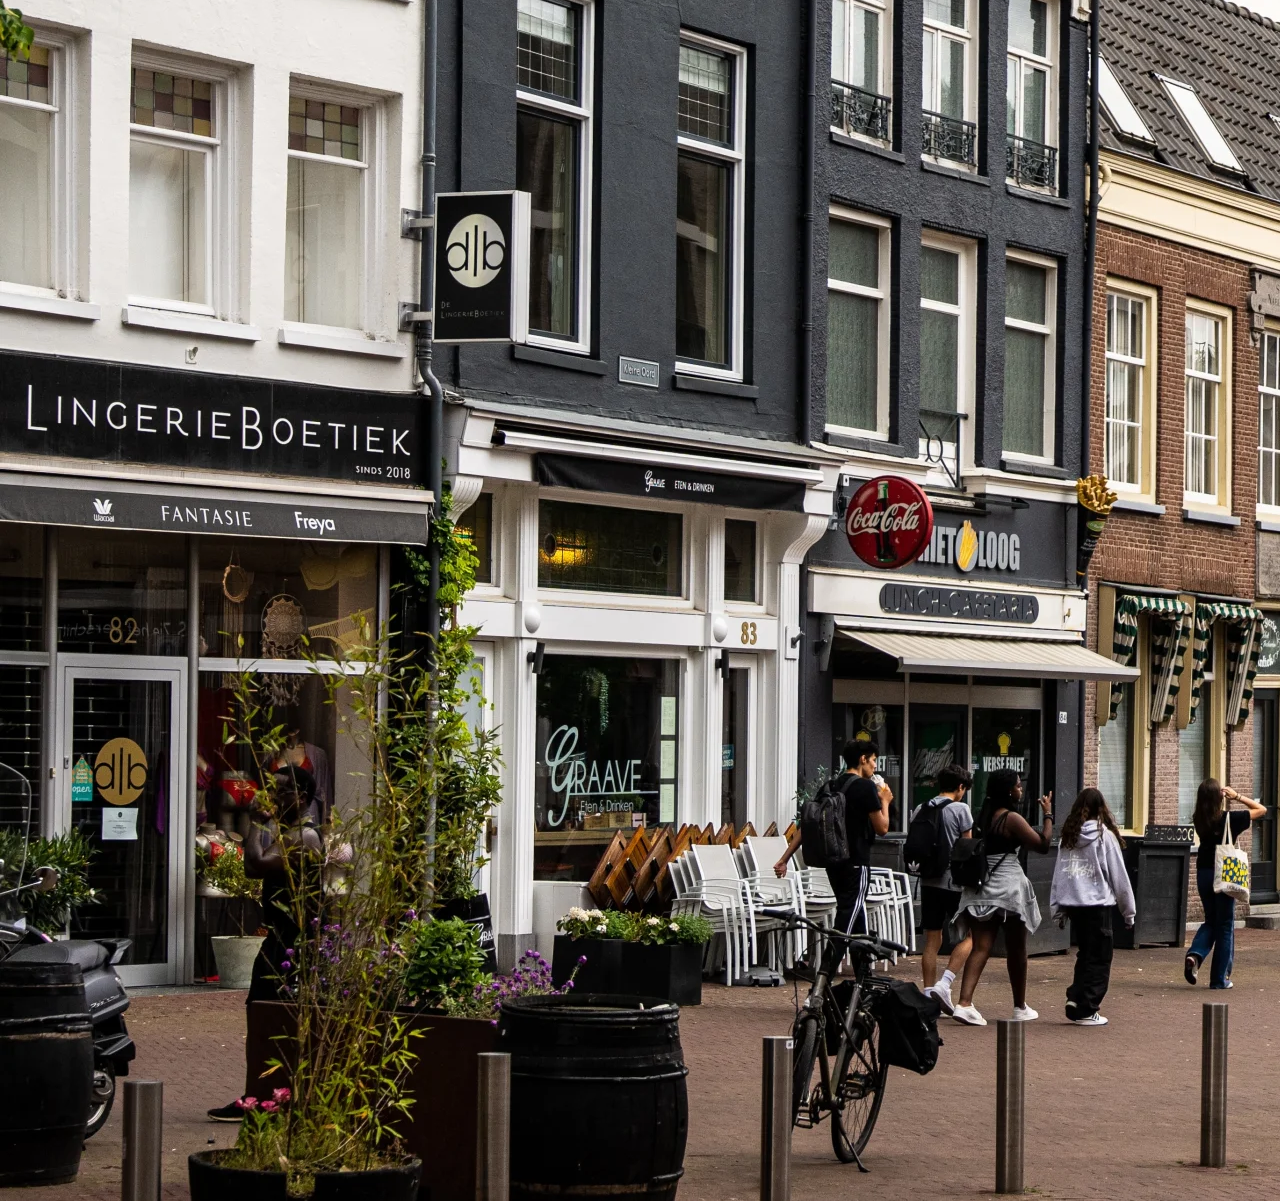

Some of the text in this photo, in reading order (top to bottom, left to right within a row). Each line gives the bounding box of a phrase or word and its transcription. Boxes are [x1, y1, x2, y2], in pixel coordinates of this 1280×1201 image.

[623, 364, 655, 378] Kleine Oord
[355, 465, 411, 479] SINDS 2018
[674, 480, 687, 490] ETEN
[687, 483, 692, 491] &
[692, 483, 714, 493] DRINKEN
[161, 505, 253, 527] FANTASIE
[295, 512, 336, 532] Freya
[847, 502, 922, 536] Coca-Cola
[109, 617, 138, 644] 82
[741, 621, 758, 645] 83
[1059, 712, 1067, 721] 84
[1006, 757, 1025, 773] FRIET
[545, 724, 643, 826] GRAAVE
[72, 785, 92, 794] open
[580, 800, 634, 814] Eten & Drinken
